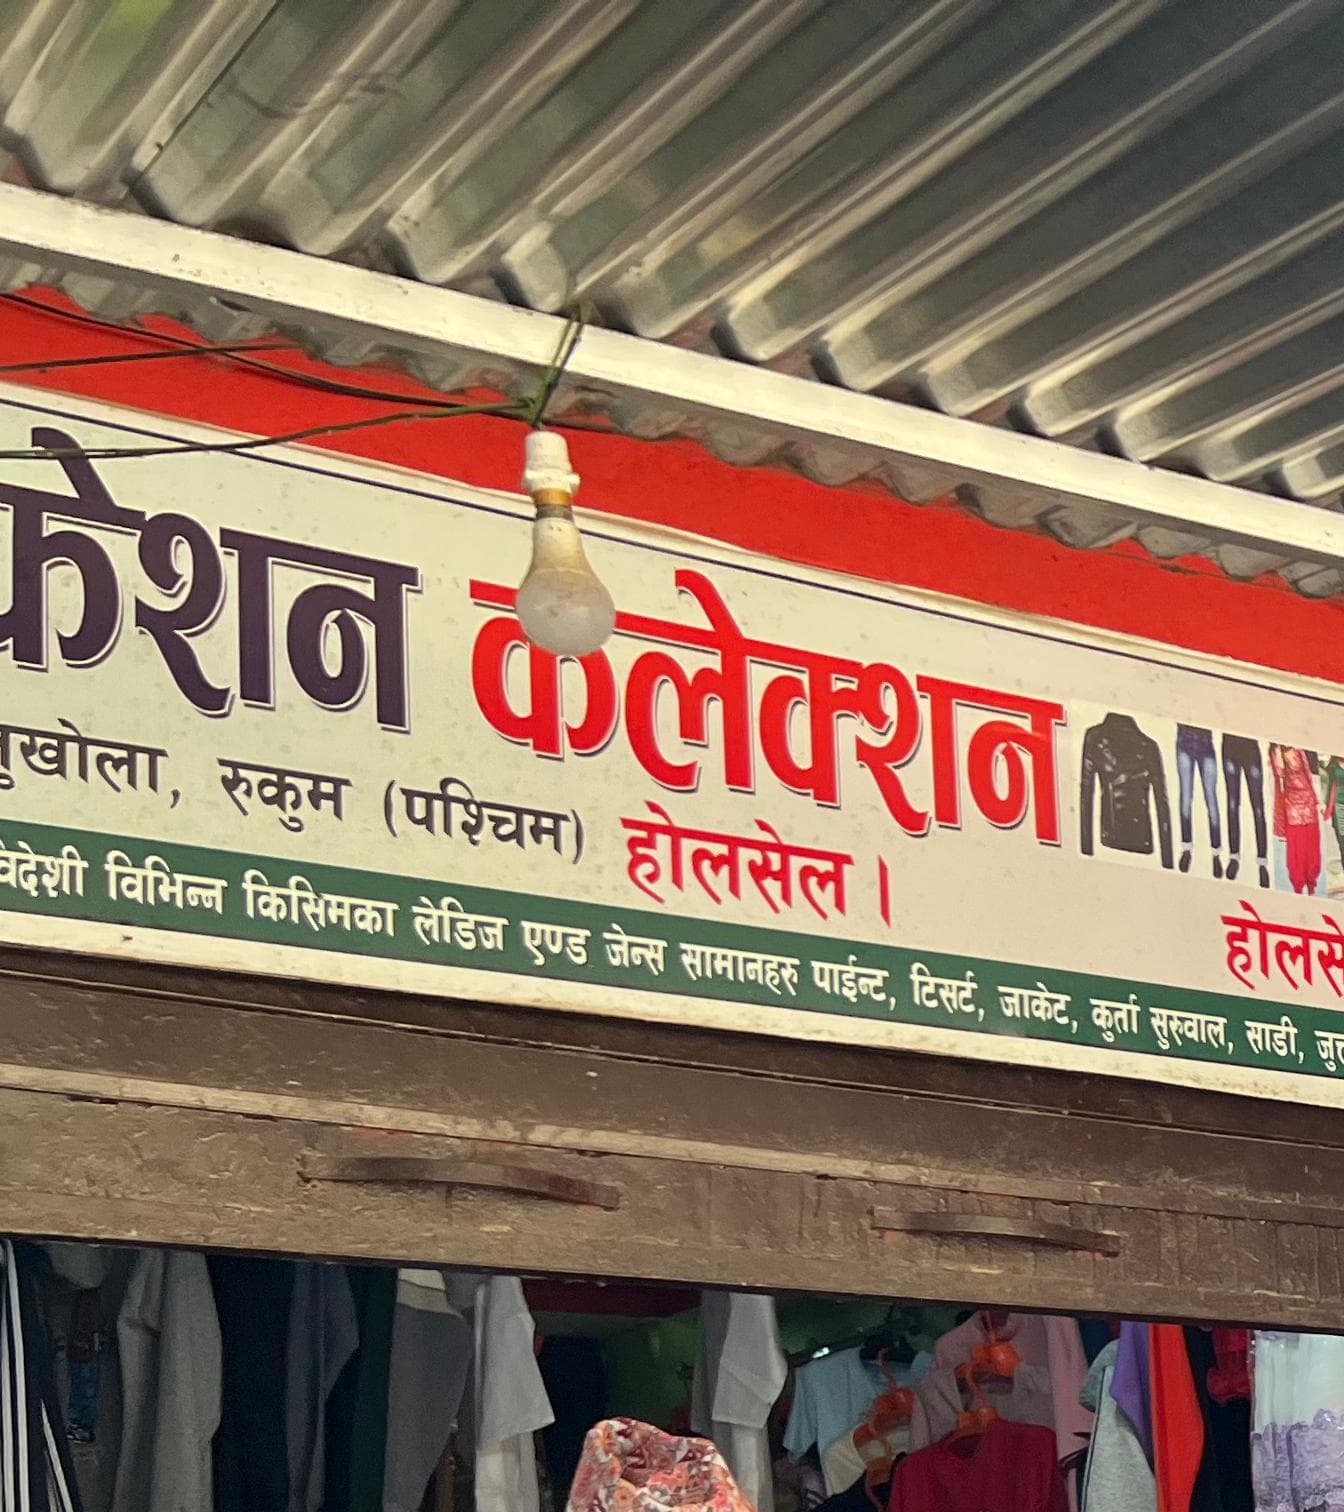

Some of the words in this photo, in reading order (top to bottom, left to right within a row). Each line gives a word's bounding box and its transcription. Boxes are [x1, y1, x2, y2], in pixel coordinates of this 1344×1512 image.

[469, 569, 1066, 846] कलेक्शन
[217, 757, 351, 832] रुकुम
[384, 777, 586, 865] (पश्चिम)
[619, 801, 854, 921] होलसेल
[104, 850, 228, 915] विभिन्न
[242, 868, 398, 938] किसिमका
[411, 896, 508, 954] लेडिज
[521, 919, 589, 966] एण्ड
[602, 922, 667, 974] जेन्स
[680, 940, 799, 997] सामानहरु
[998, 979, 1078, 1034] जाकेट,
[1090, 993, 1140, 1042] कुर्ता
[1149, 1004, 1233, 1055] सुरुवाल,
[1244, 1015, 1304, 1064] साडी,
